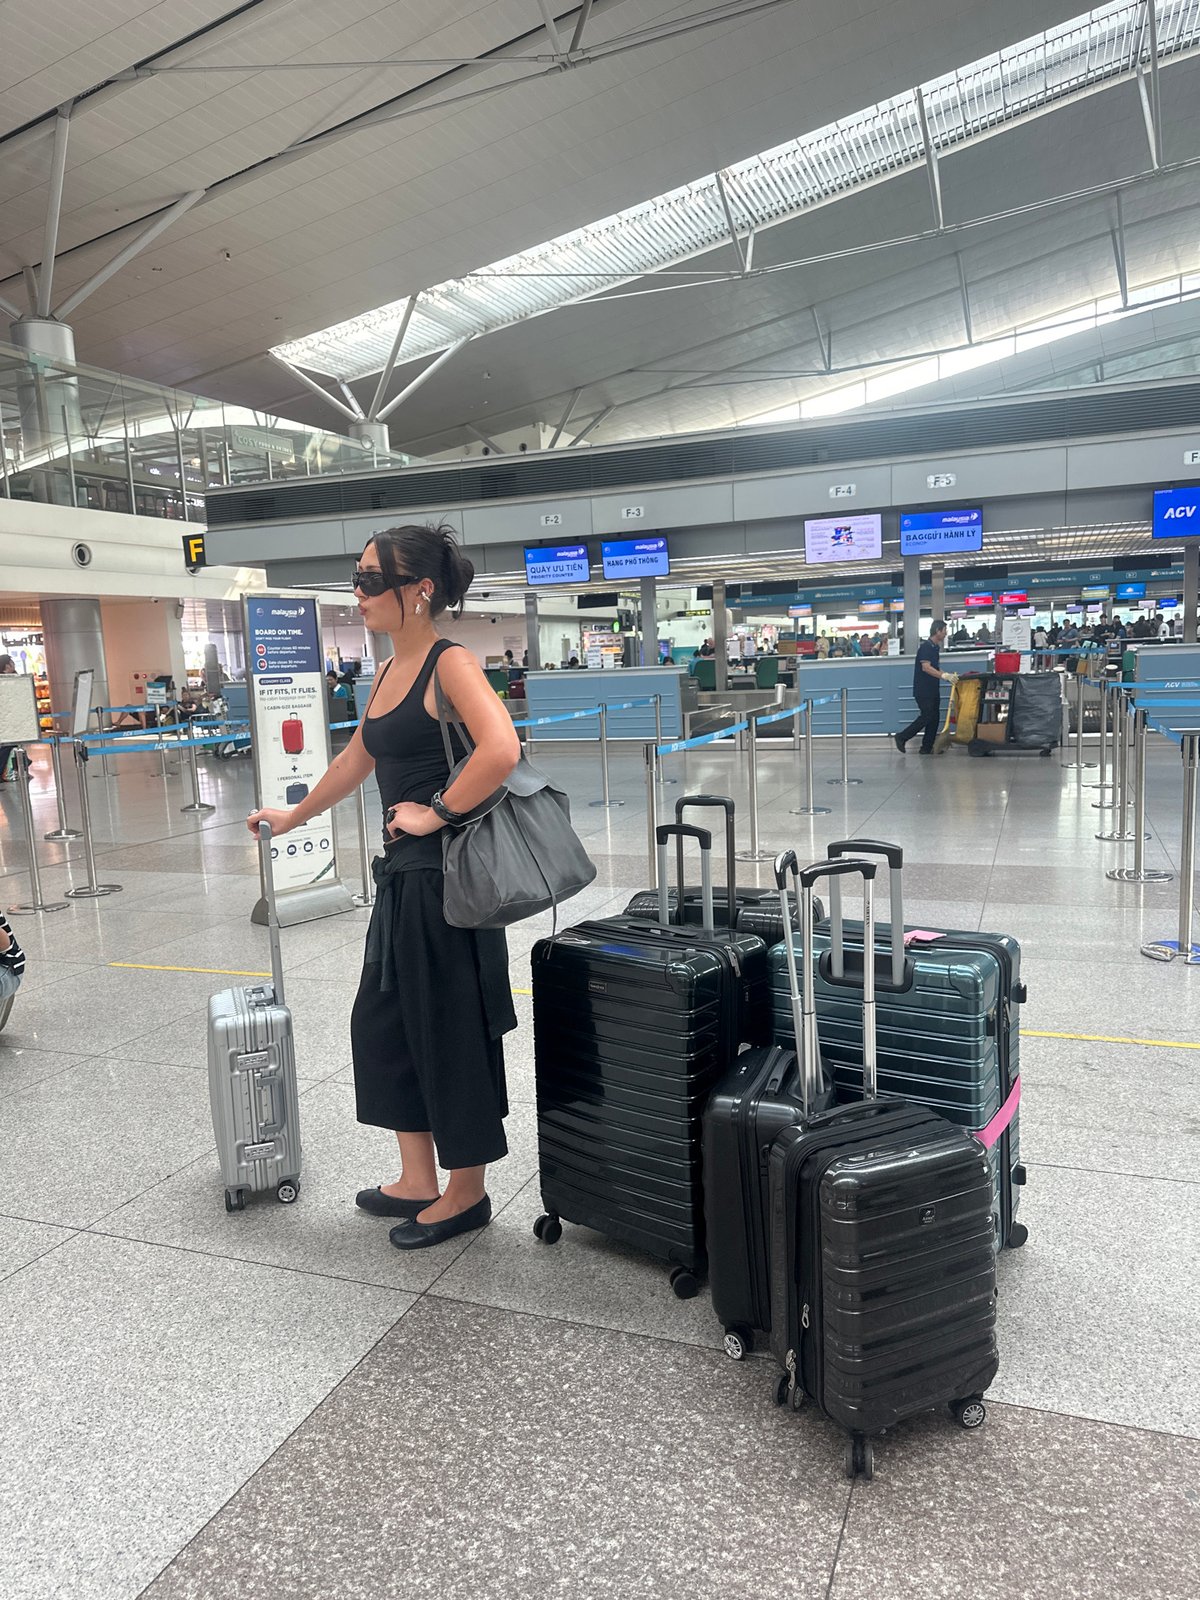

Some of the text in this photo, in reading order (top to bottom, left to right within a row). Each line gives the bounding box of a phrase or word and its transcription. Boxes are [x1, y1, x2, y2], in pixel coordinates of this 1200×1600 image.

[934, 476, 952, 486] F-5
[836, 486, 852, 496] F-4
[626, 508, 640, 517] F-3
[1164, 506, 1196, 519] ACV
[545, 516, 559, 524] F-2
[189, 539, 203, 562] F
[271, 609, 297, 617] malaysia
